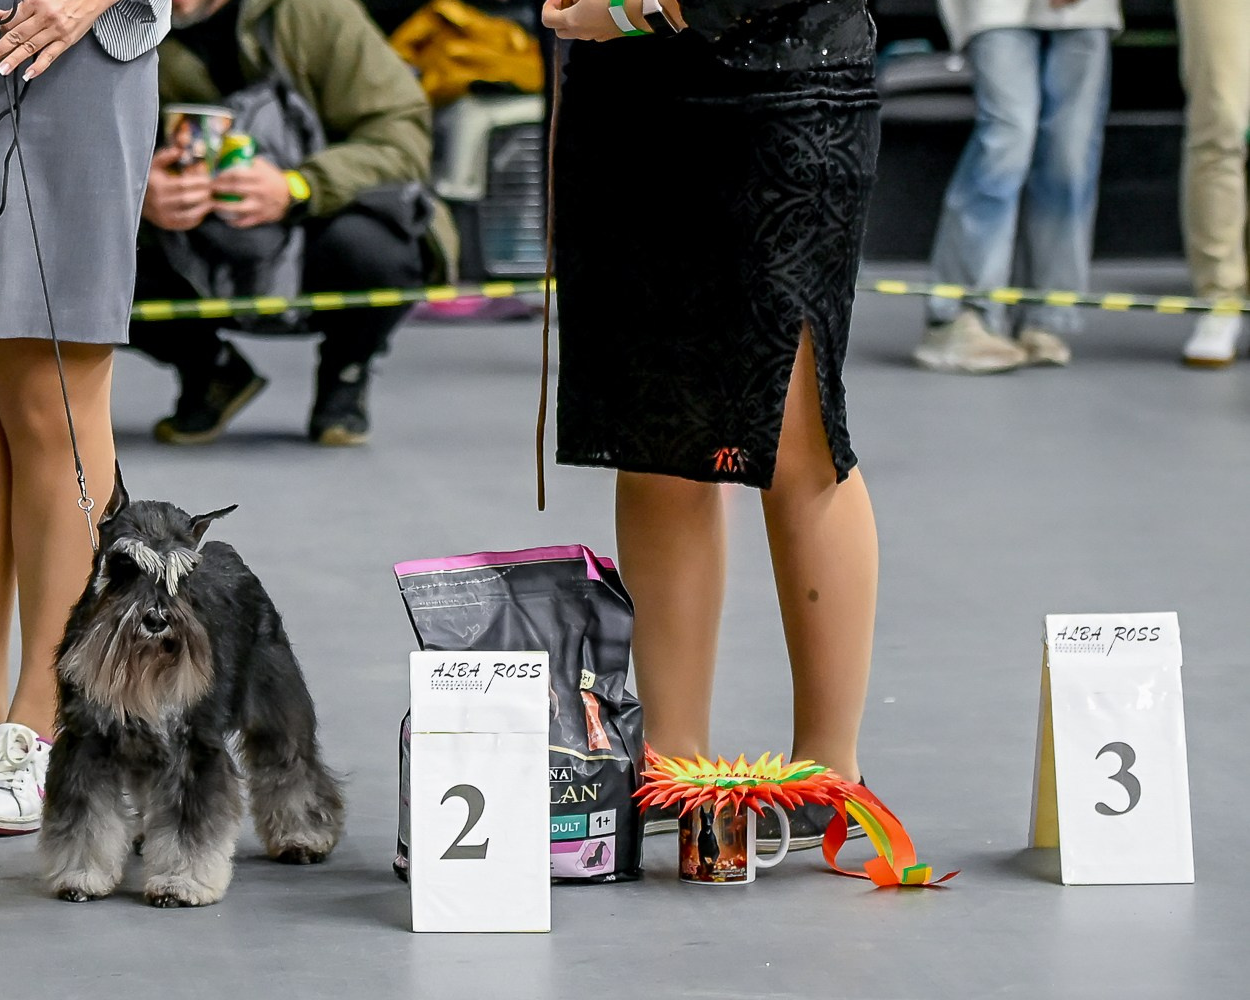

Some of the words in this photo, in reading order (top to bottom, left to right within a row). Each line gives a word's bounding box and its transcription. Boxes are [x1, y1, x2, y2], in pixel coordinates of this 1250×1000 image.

[1055, 626, 1102, 642] ALBA
[1106, 626, 1161, 656] ROSS
[431, 662, 482, 678] ALBA
[485, 663, 542, 693] ROSS
[549, 783, 597, 804] LAN
[1095, 741, 1141, 816] 3
[440, 784, 489, 860] 2
[551, 822, 580, 833] DULT
[595, 816, 610, 829] 1+
